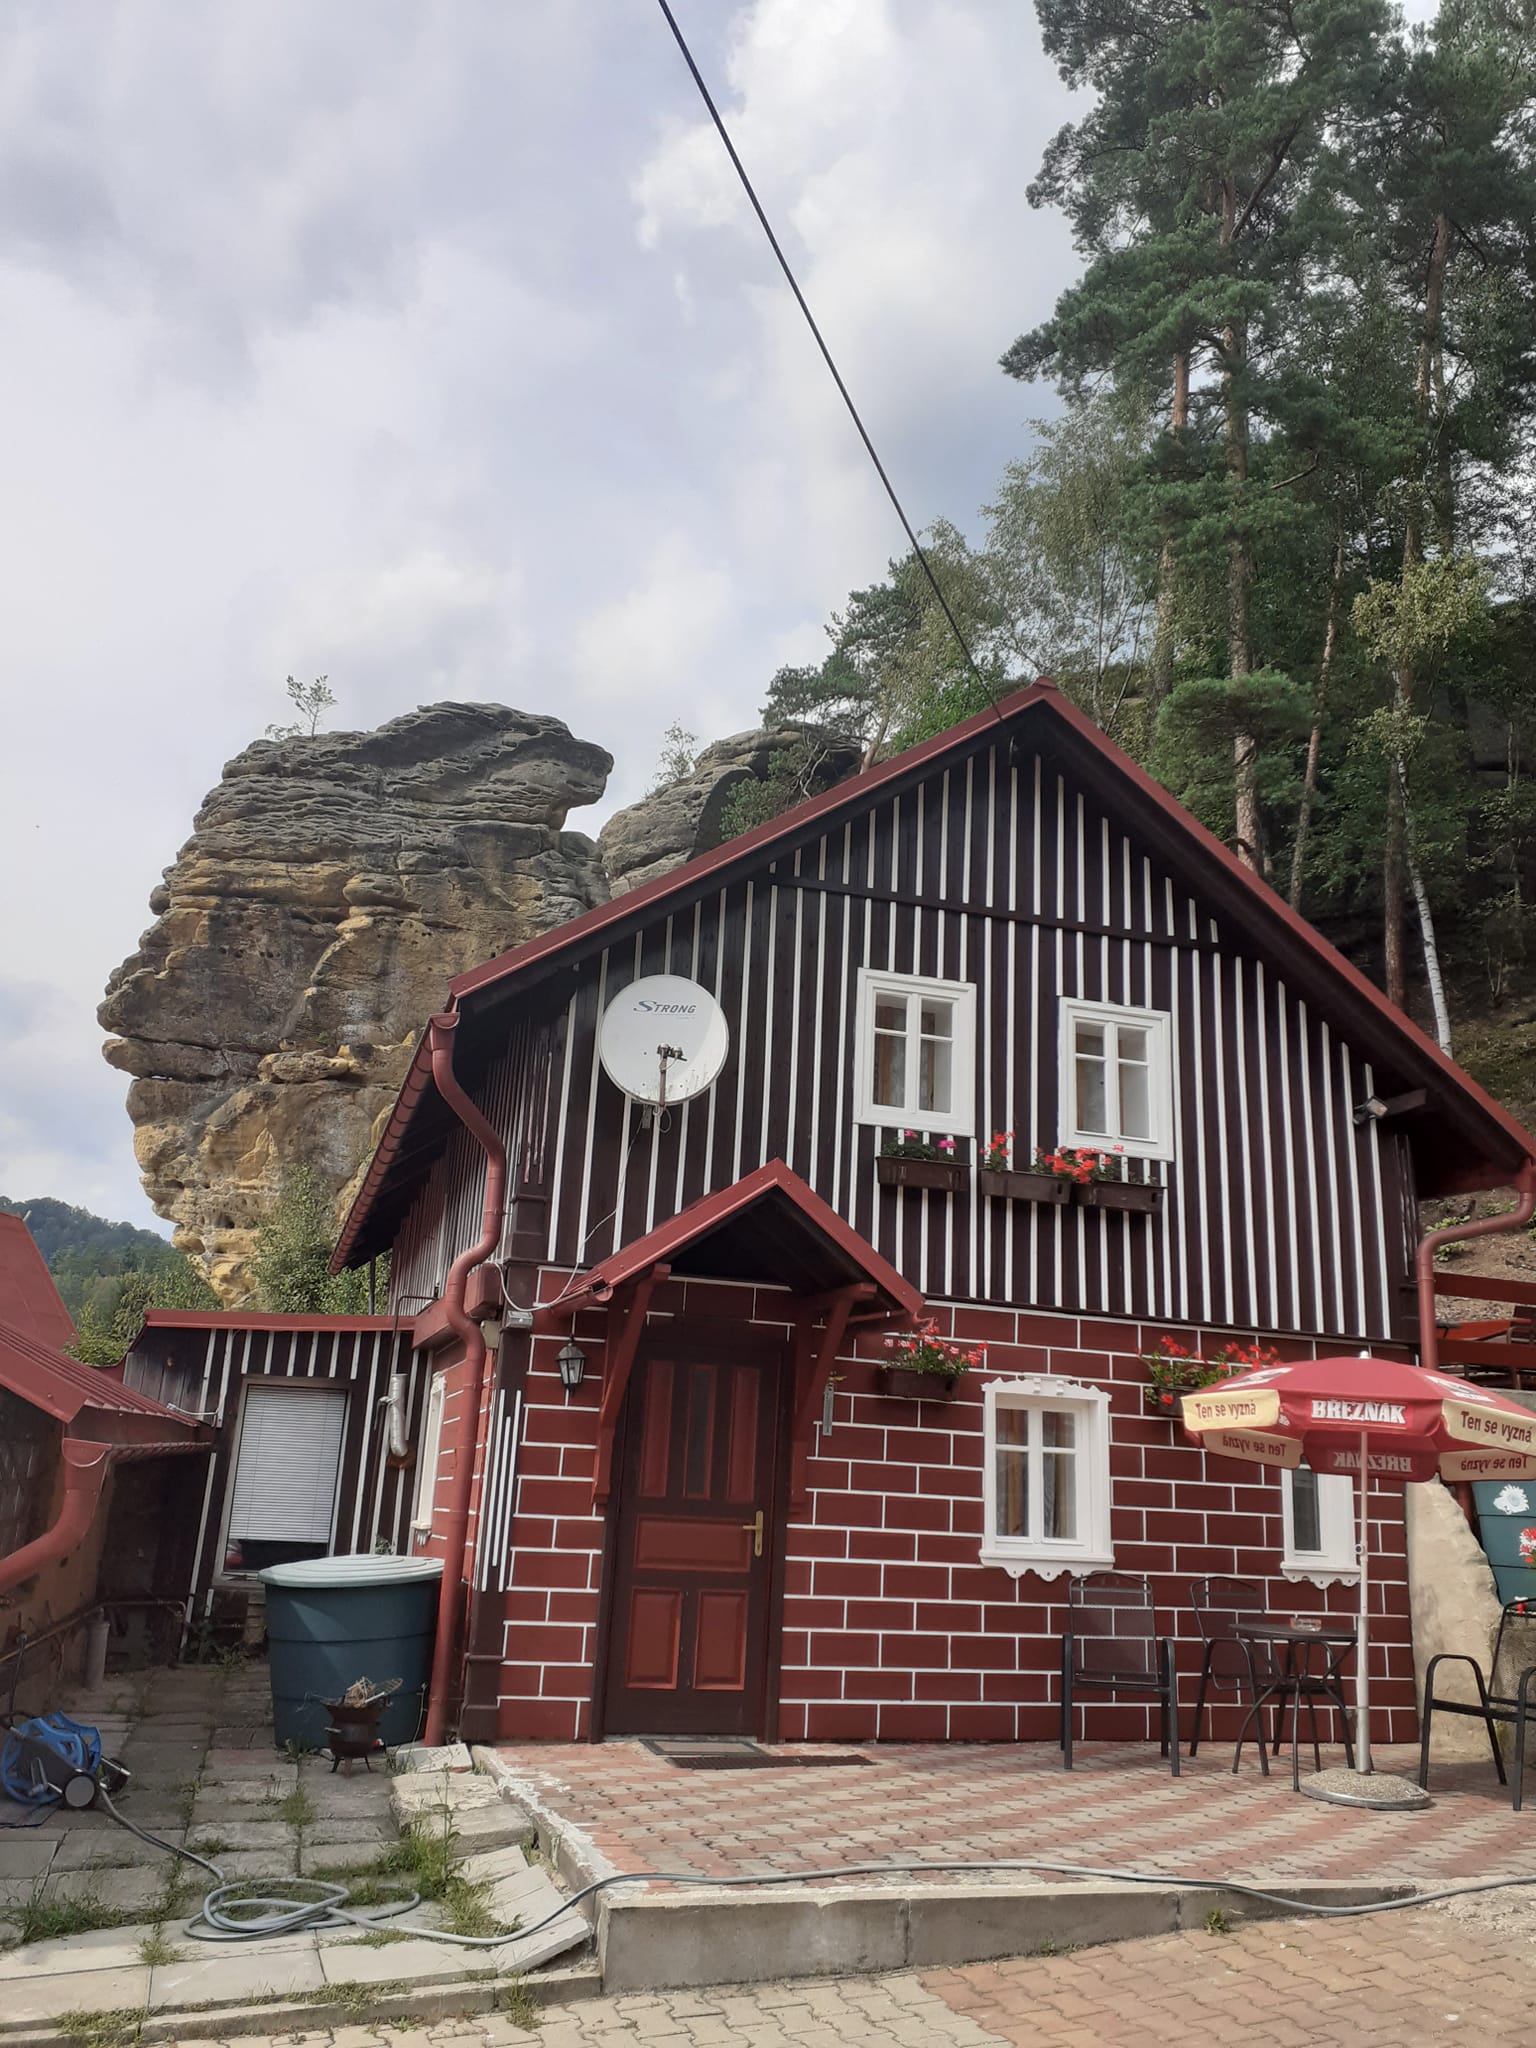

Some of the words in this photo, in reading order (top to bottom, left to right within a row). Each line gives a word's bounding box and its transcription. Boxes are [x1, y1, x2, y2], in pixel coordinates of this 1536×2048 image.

[1195, 1403, 1213, 1419] Ten
[1215, 1404, 1226, 1417] se
[1228, 1400, 1256, 1420] vyzná
[1461, 1410, 1482, 1431] Ten
[1484, 1419, 1498, 1434] se
[1501, 1422, 1532, 1443] vyzná
